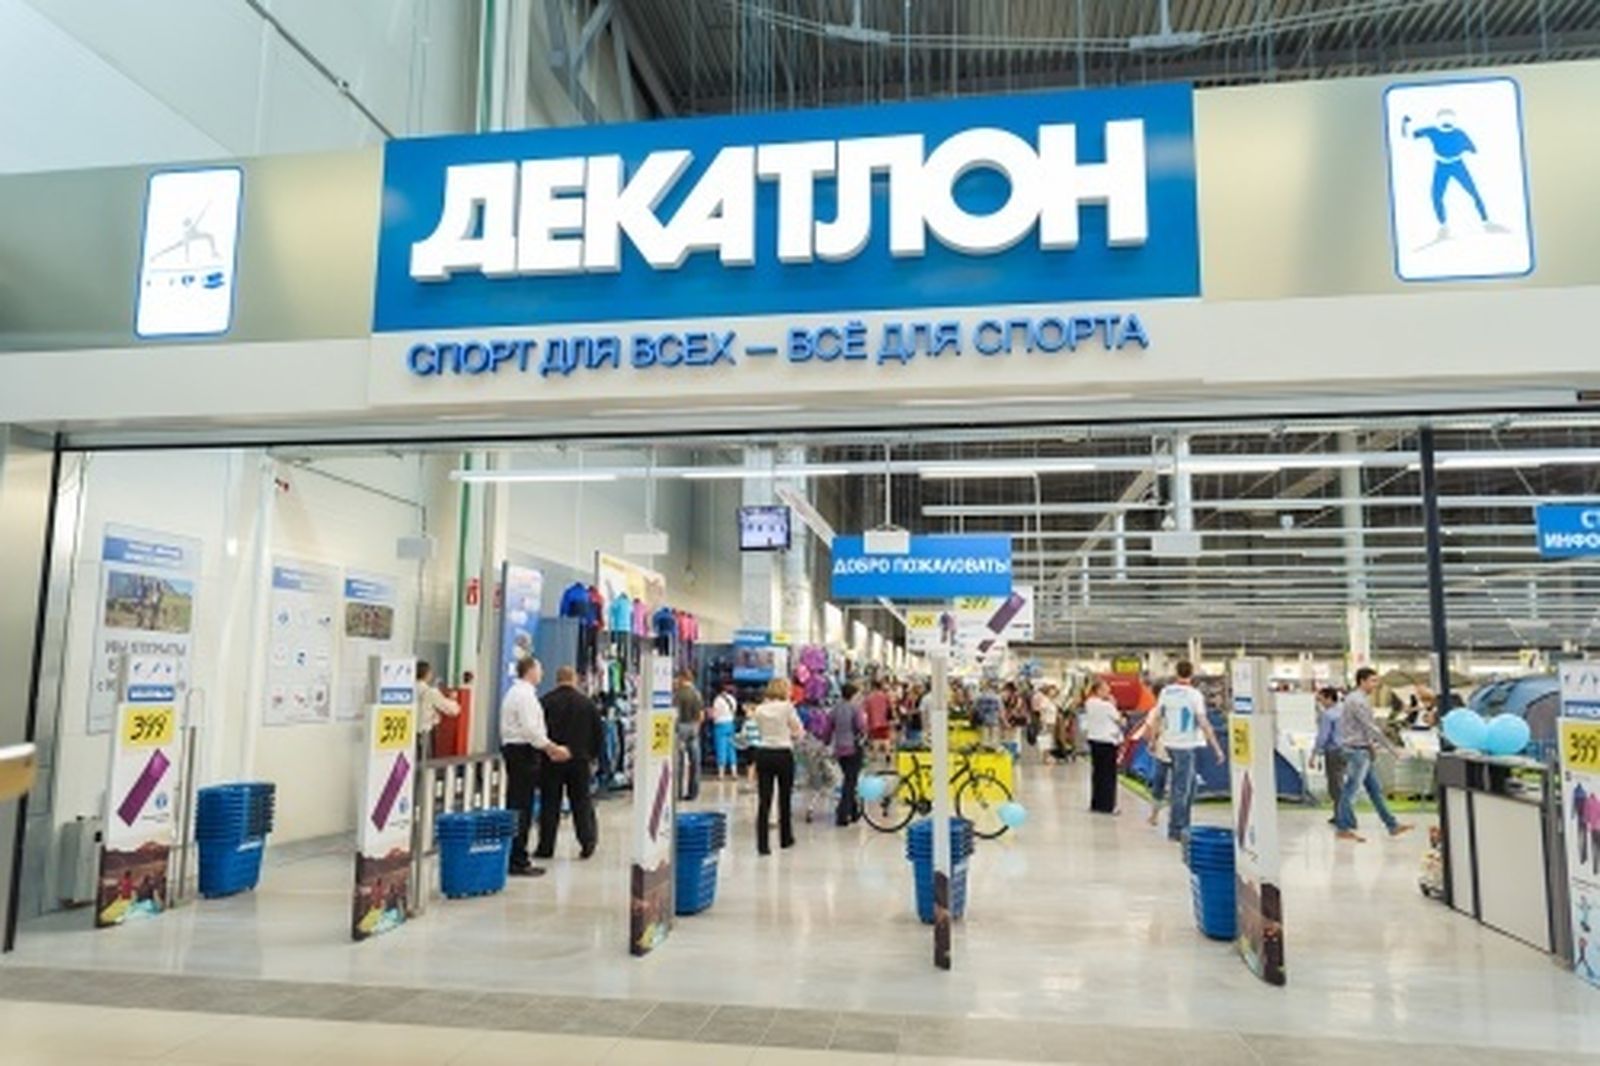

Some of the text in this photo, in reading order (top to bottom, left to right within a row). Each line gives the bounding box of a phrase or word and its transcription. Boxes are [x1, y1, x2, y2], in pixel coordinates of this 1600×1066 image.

[409, 117, 1149, 283] ДЕКАТЛОН
[407, 339, 538, 376] СПОРТ
[540, 335, 621, 377] ДЛЯ
[629, 330, 736, 369] ВСЕХ
[786, 319, 868, 363] ВСЁ
[875, 319, 962, 366] ДЛЯ
[972, 312, 1150, 357] СПОРТА
[1581, 509, 1600, 529] С
[832, 556, 891, 574] ДОБРО
